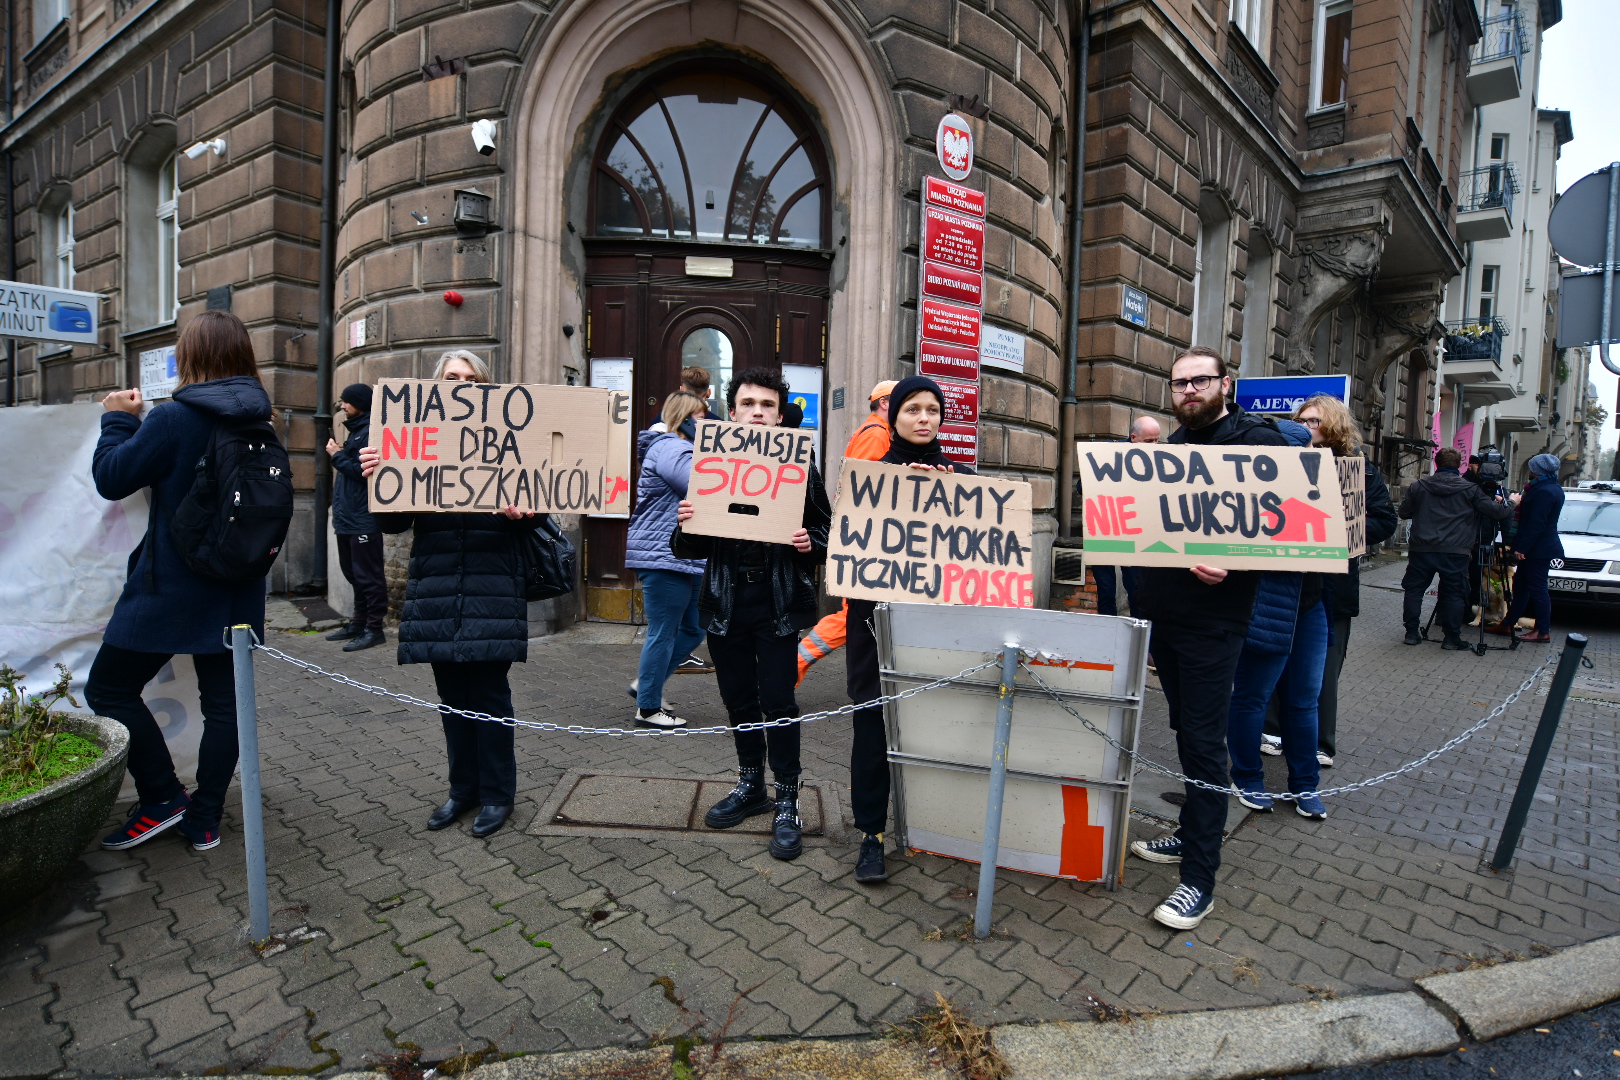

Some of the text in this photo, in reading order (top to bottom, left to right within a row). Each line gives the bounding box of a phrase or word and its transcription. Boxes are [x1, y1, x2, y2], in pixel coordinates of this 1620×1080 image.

[931, 190, 982, 213] MIASTA POZNANIA
[947, 186, 967, 199] URZĄD
[944, 215, 960, 225] MIASTA
[961, 219, 983, 232] POZNANIA
[927, 274, 943, 285] BIURO
[1125, 297, 1144, 314] Matejki
[922, 353, 936, 363] BIURO
[381, 383, 534, 431] MIASTO
[382, 425, 522, 466] NIE DBA
[700, 424, 811, 463] EKSMISJE
[374, 465, 403, 505] O
[411, 458, 604, 511] MIESZKAŃCÓW
[694, 456, 806, 501] STOP
[1085, 448, 1322, 501] WODA TO !
[850, 470, 1016, 525] WITAMY
[1085, 490, 1286, 539] NIE LUKSUS
[840, 515, 1031, 567] W DEMOKRA-
[831, 553, 1034, 609] TYCZNEJ POLSCE
